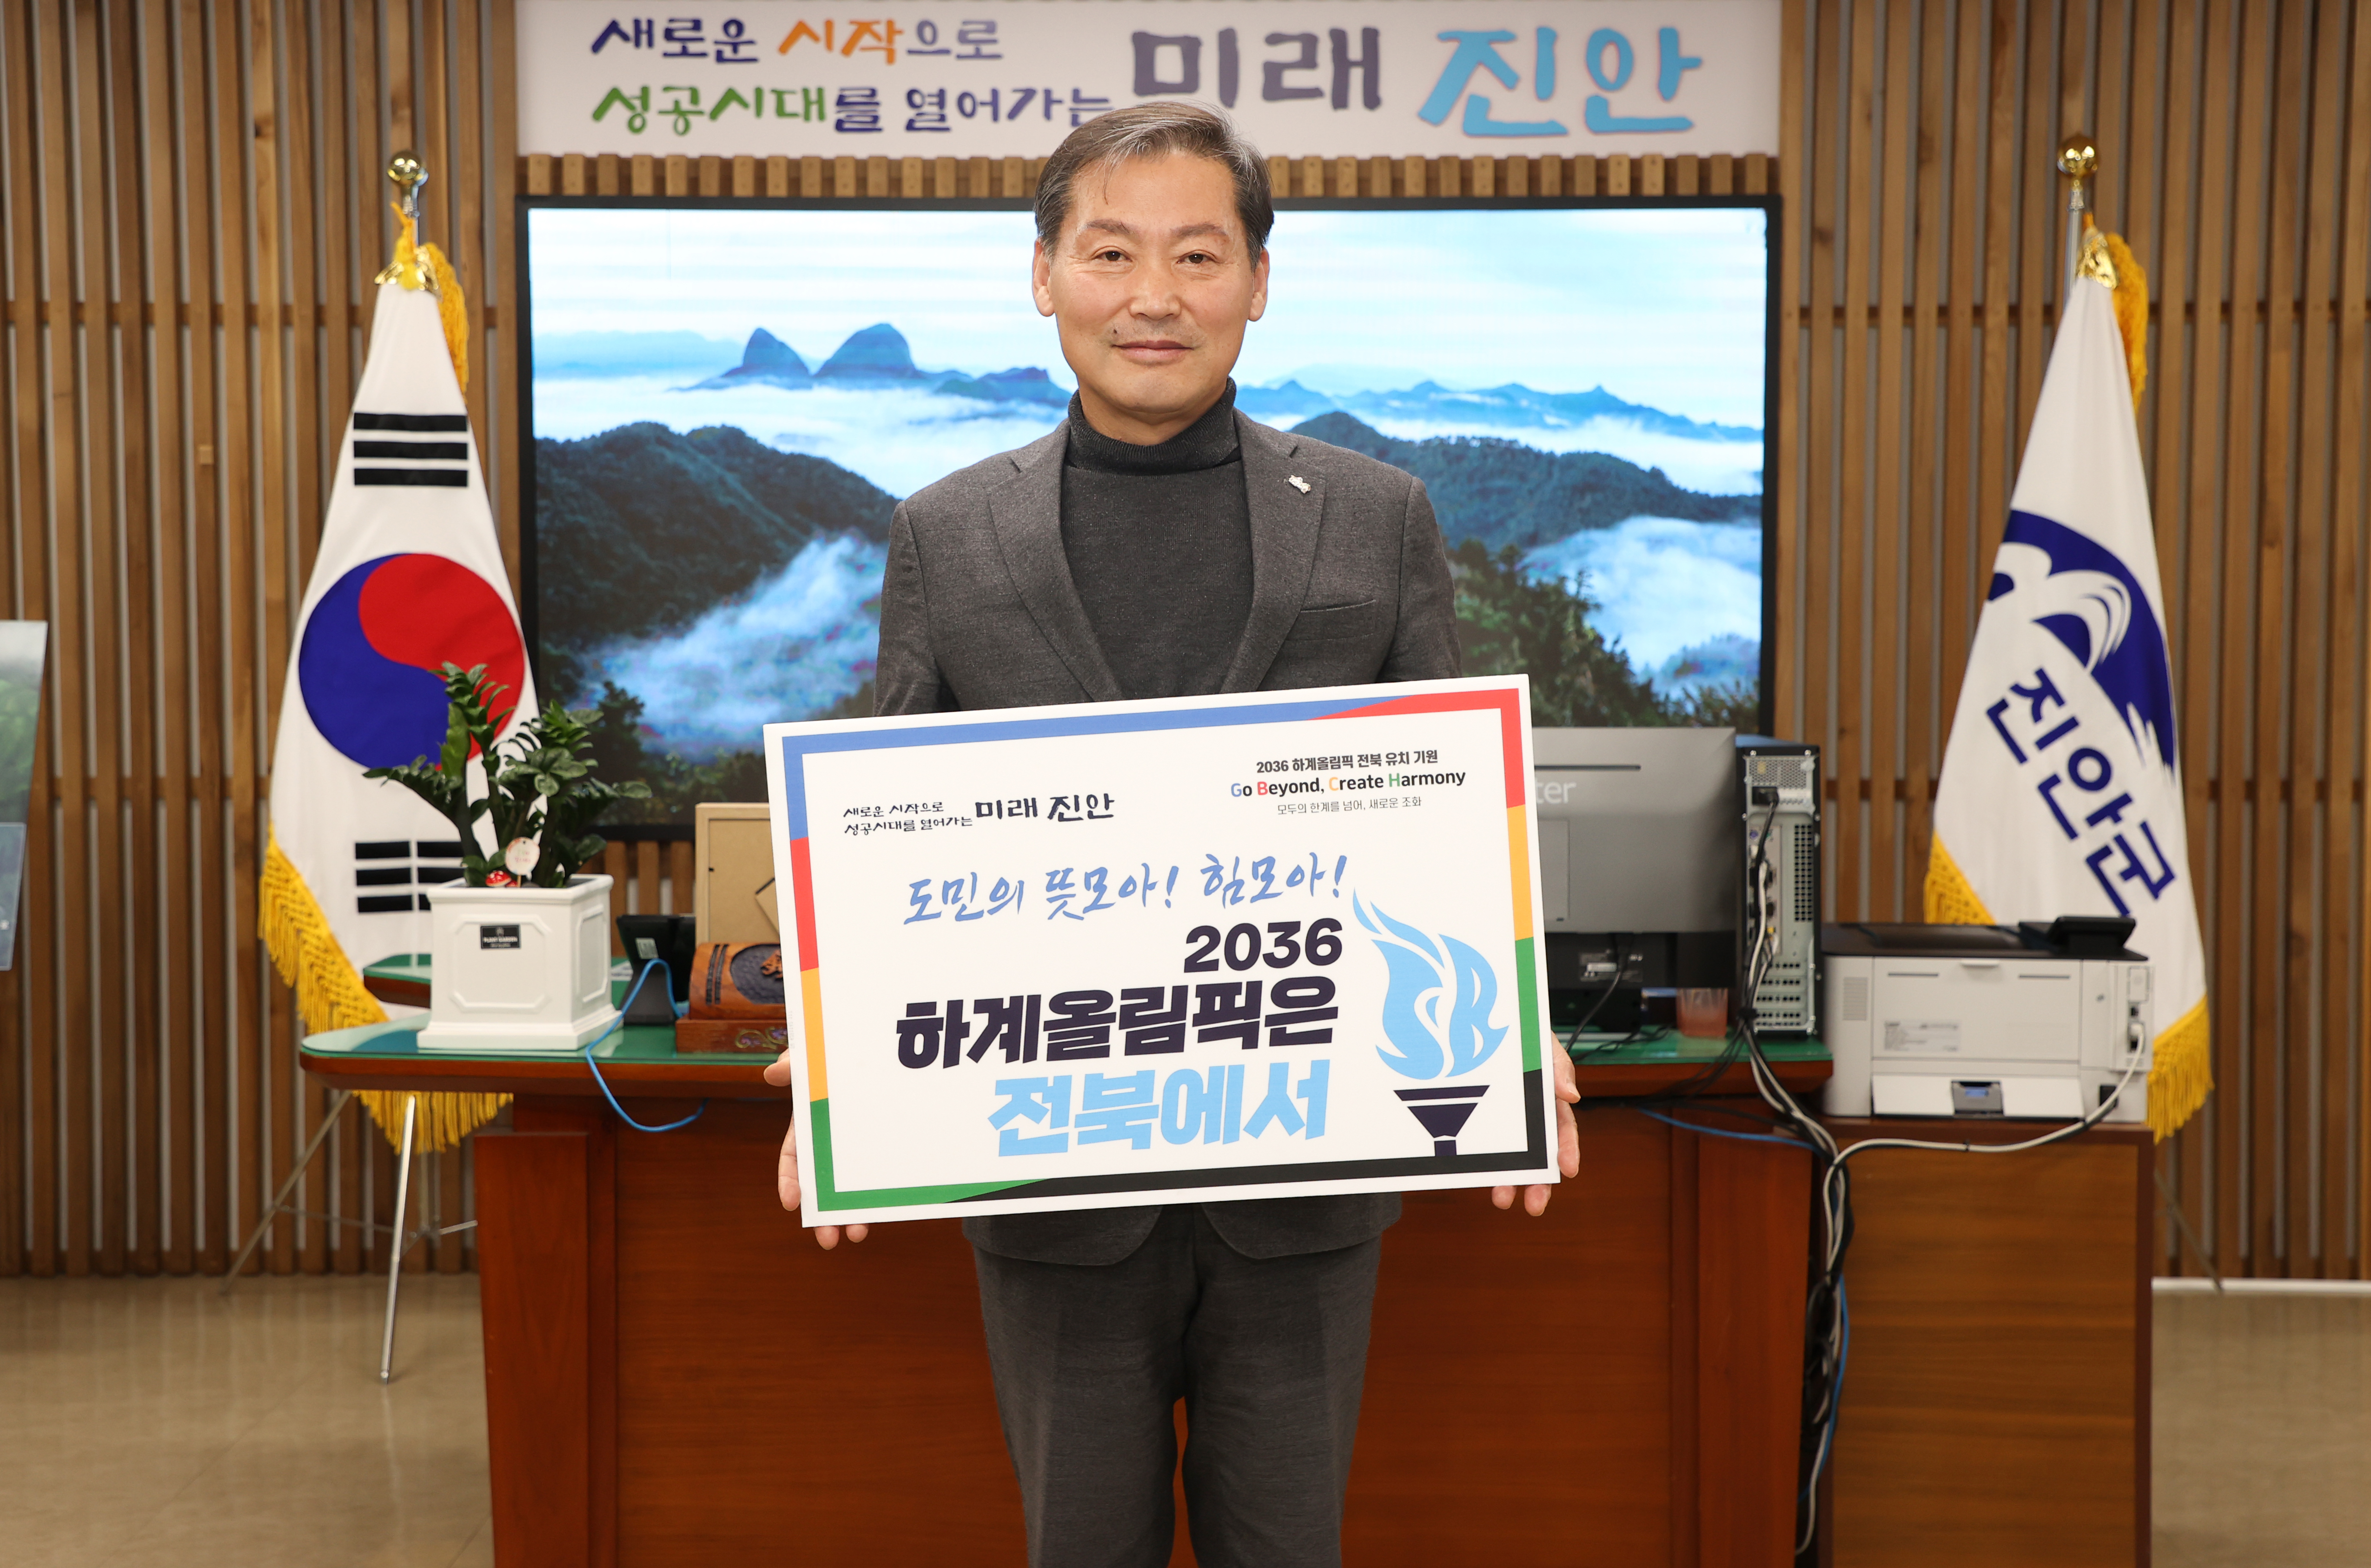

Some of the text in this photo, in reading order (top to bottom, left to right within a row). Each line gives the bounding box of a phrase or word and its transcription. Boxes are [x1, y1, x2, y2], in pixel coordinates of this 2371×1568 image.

[591, 19, 1003, 64] 새로운 시작으로
[1131, 25, 1703, 137] 미래 진안
[592, 86, 1114, 136] 성공시대를 열어가는
[1231, 772, 1466, 797] Go Beyond, Create Harmony
[1257, 749, 1438, 773] 2036 하계올림픽 전북 유치 기원
[843, 802, 944, 818] 새로운 시작으로
[975, 793, 1115, 822] 미래 진안
[1278, 796, 1422, 815] 모두의 한계를 넘어, 새로운 조화
[1986, 667, 2176, 917] 진안군
[844, 816, 973, 836] 성공시대를 열어가는
[903, 852, 1347, 925] 도민의 뜻모아! 힘모아!
[1184, 918, 1343, 973] 2036
[896, 976, 1338, 1069] 하계올림픽은
[987, 1059, 1330, 1157] 전북에서
